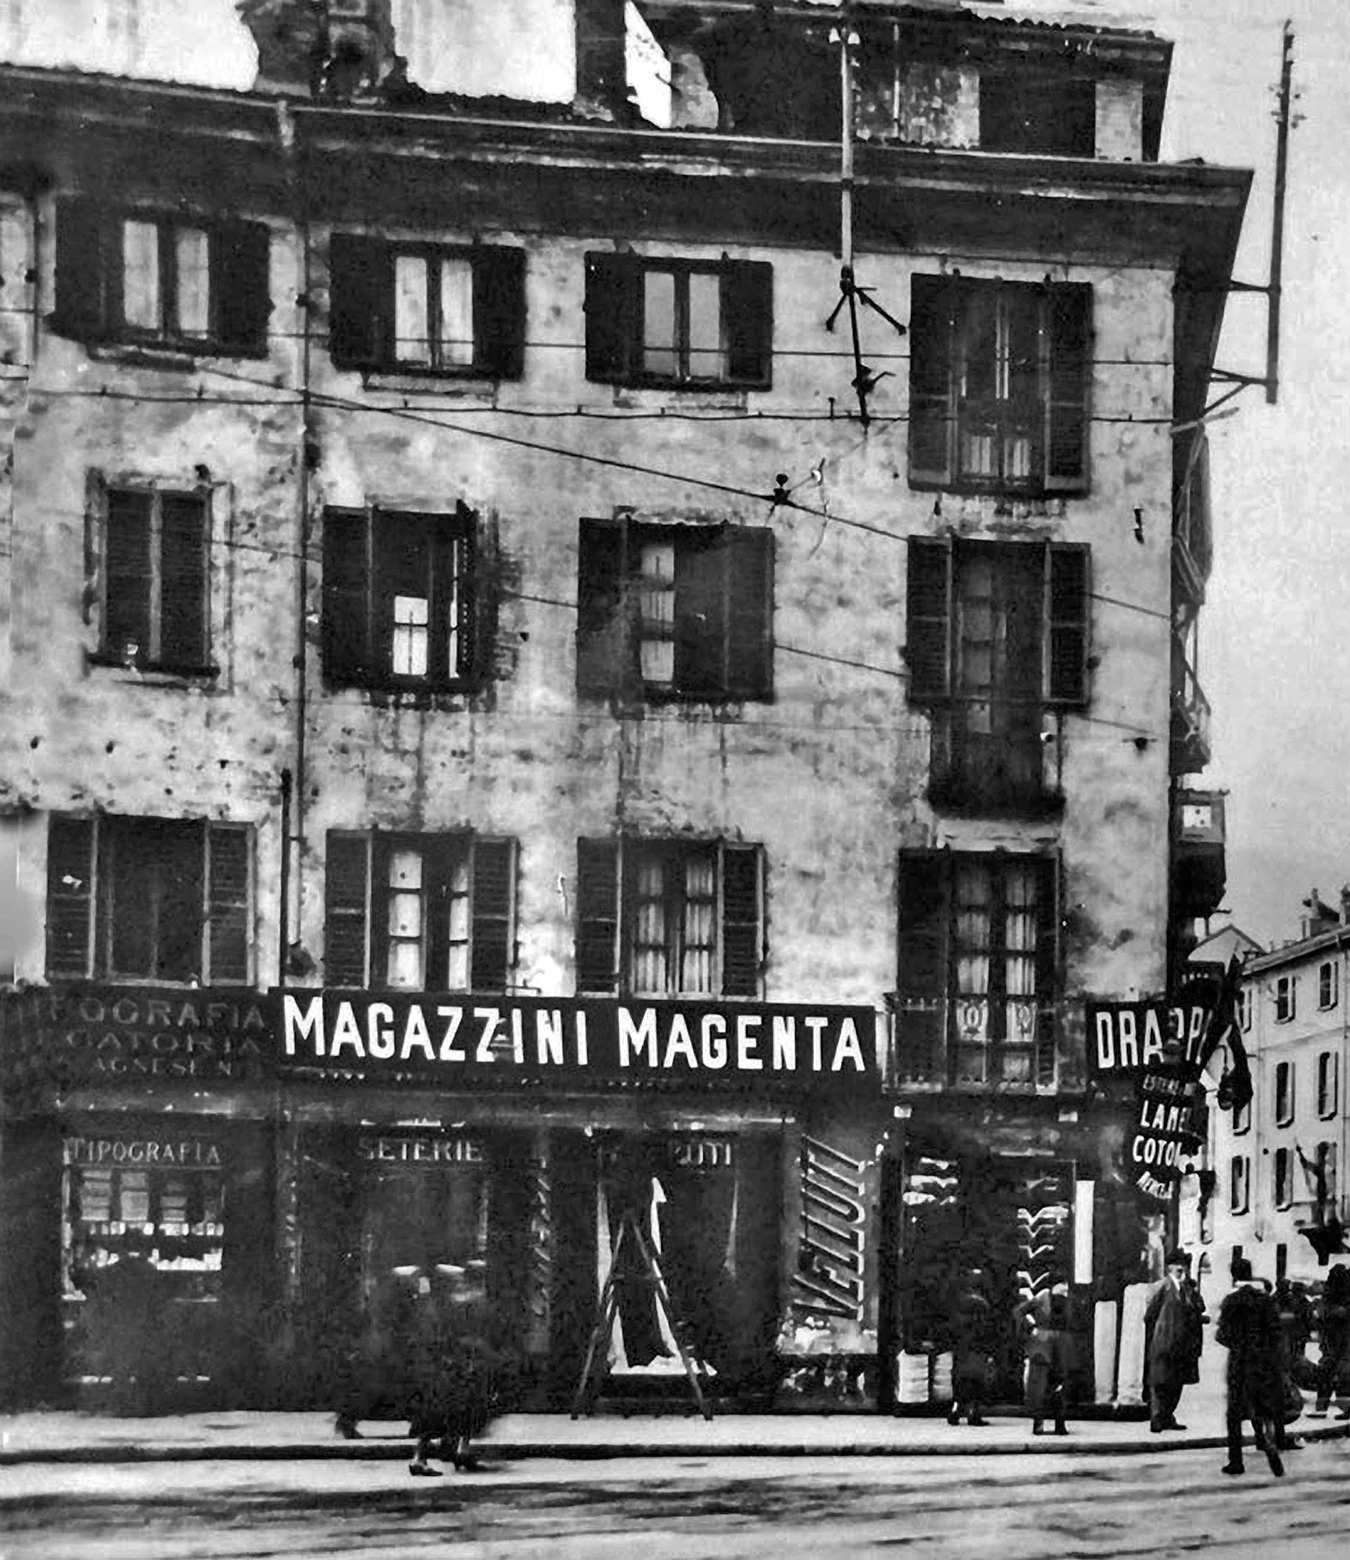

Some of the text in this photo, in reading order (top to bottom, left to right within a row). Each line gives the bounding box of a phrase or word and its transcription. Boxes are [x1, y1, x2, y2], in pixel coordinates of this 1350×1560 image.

[283, 995, 865, 1071] MAGAZZINI MAGENTA
[71, 1137, 220, 1164] TIPOGRAFIA
[358, 1137, 484, 1161] SETERIE
[793, 1132, 866, 1323] VELLUTI
